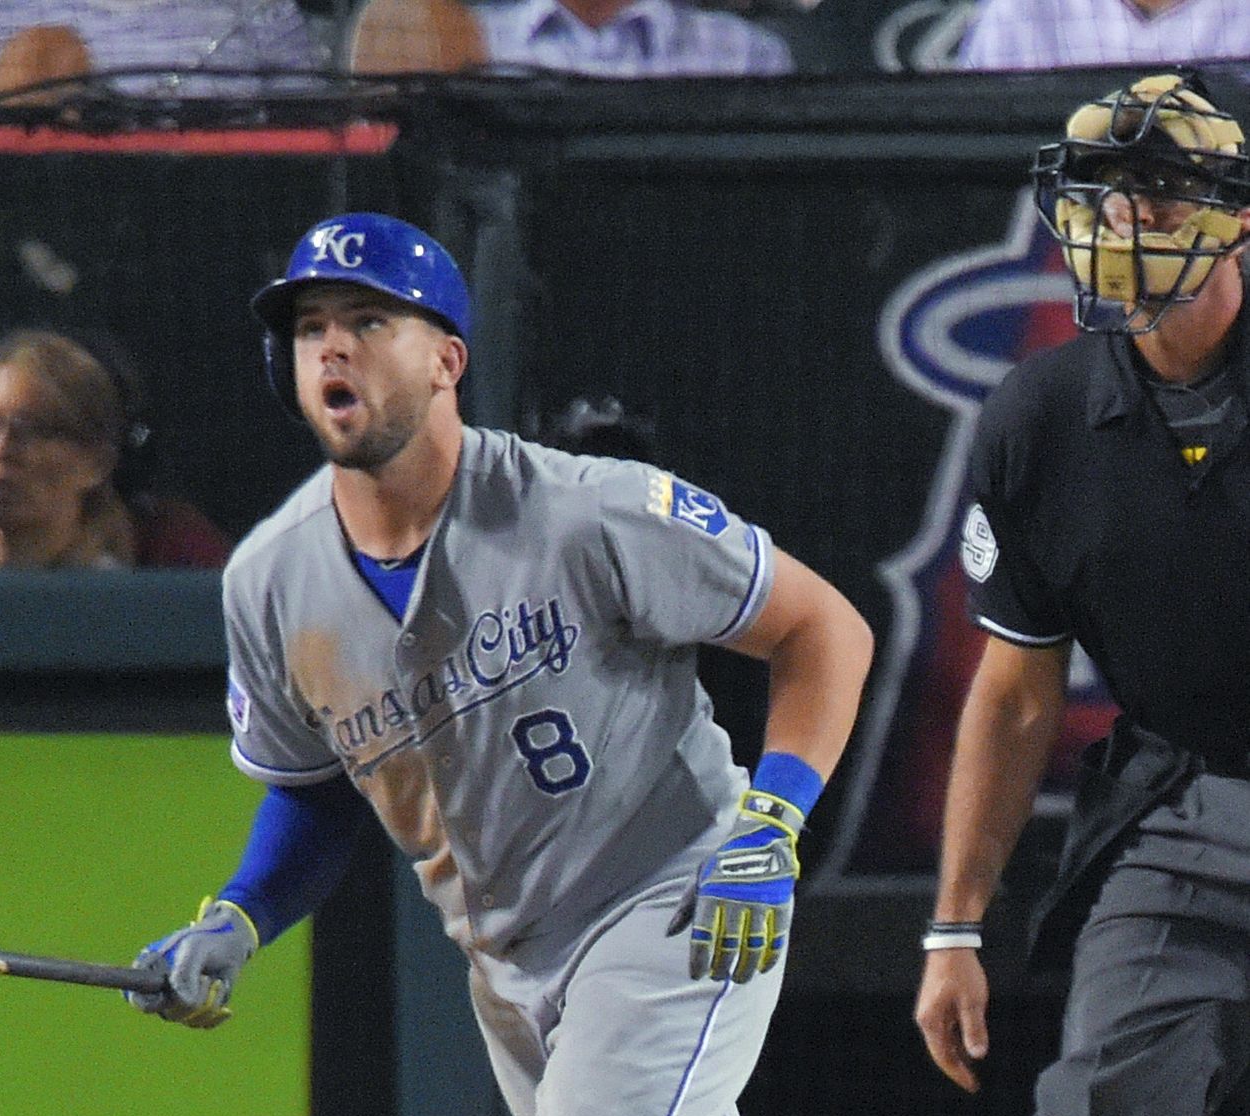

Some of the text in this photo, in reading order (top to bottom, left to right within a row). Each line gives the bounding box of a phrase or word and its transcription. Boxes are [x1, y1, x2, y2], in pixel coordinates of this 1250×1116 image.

[311, 224, 367, 269] KC
[677, 489, 718, 532] KC
[465, 597, 581, 689] City
[509, 706, 594, 798] 8
